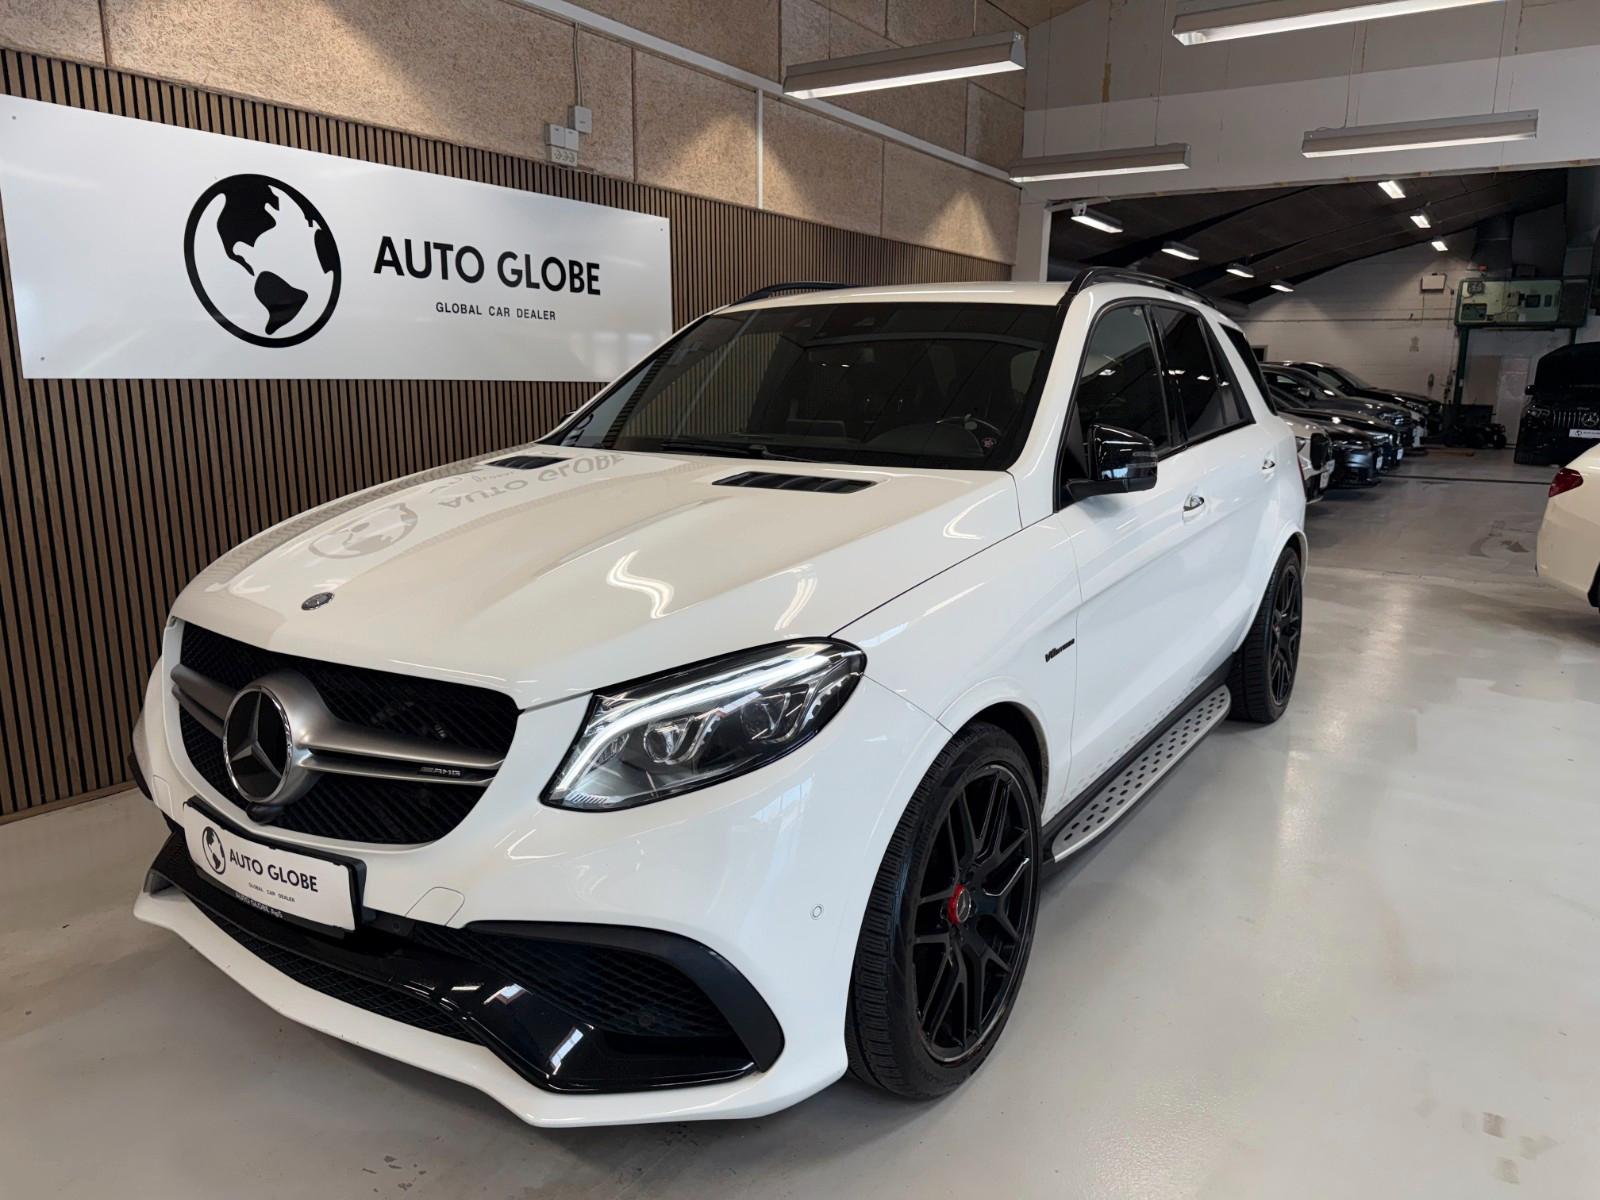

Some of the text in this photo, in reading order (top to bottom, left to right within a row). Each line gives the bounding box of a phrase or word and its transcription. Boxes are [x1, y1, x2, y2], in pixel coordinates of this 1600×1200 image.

[373, 235, 601, 296] AUTO GLOBE
[435, 301, 556, 321] GLOBAL CAR DEALER
[229, 848, 319, 893] AUTO GLOBE
